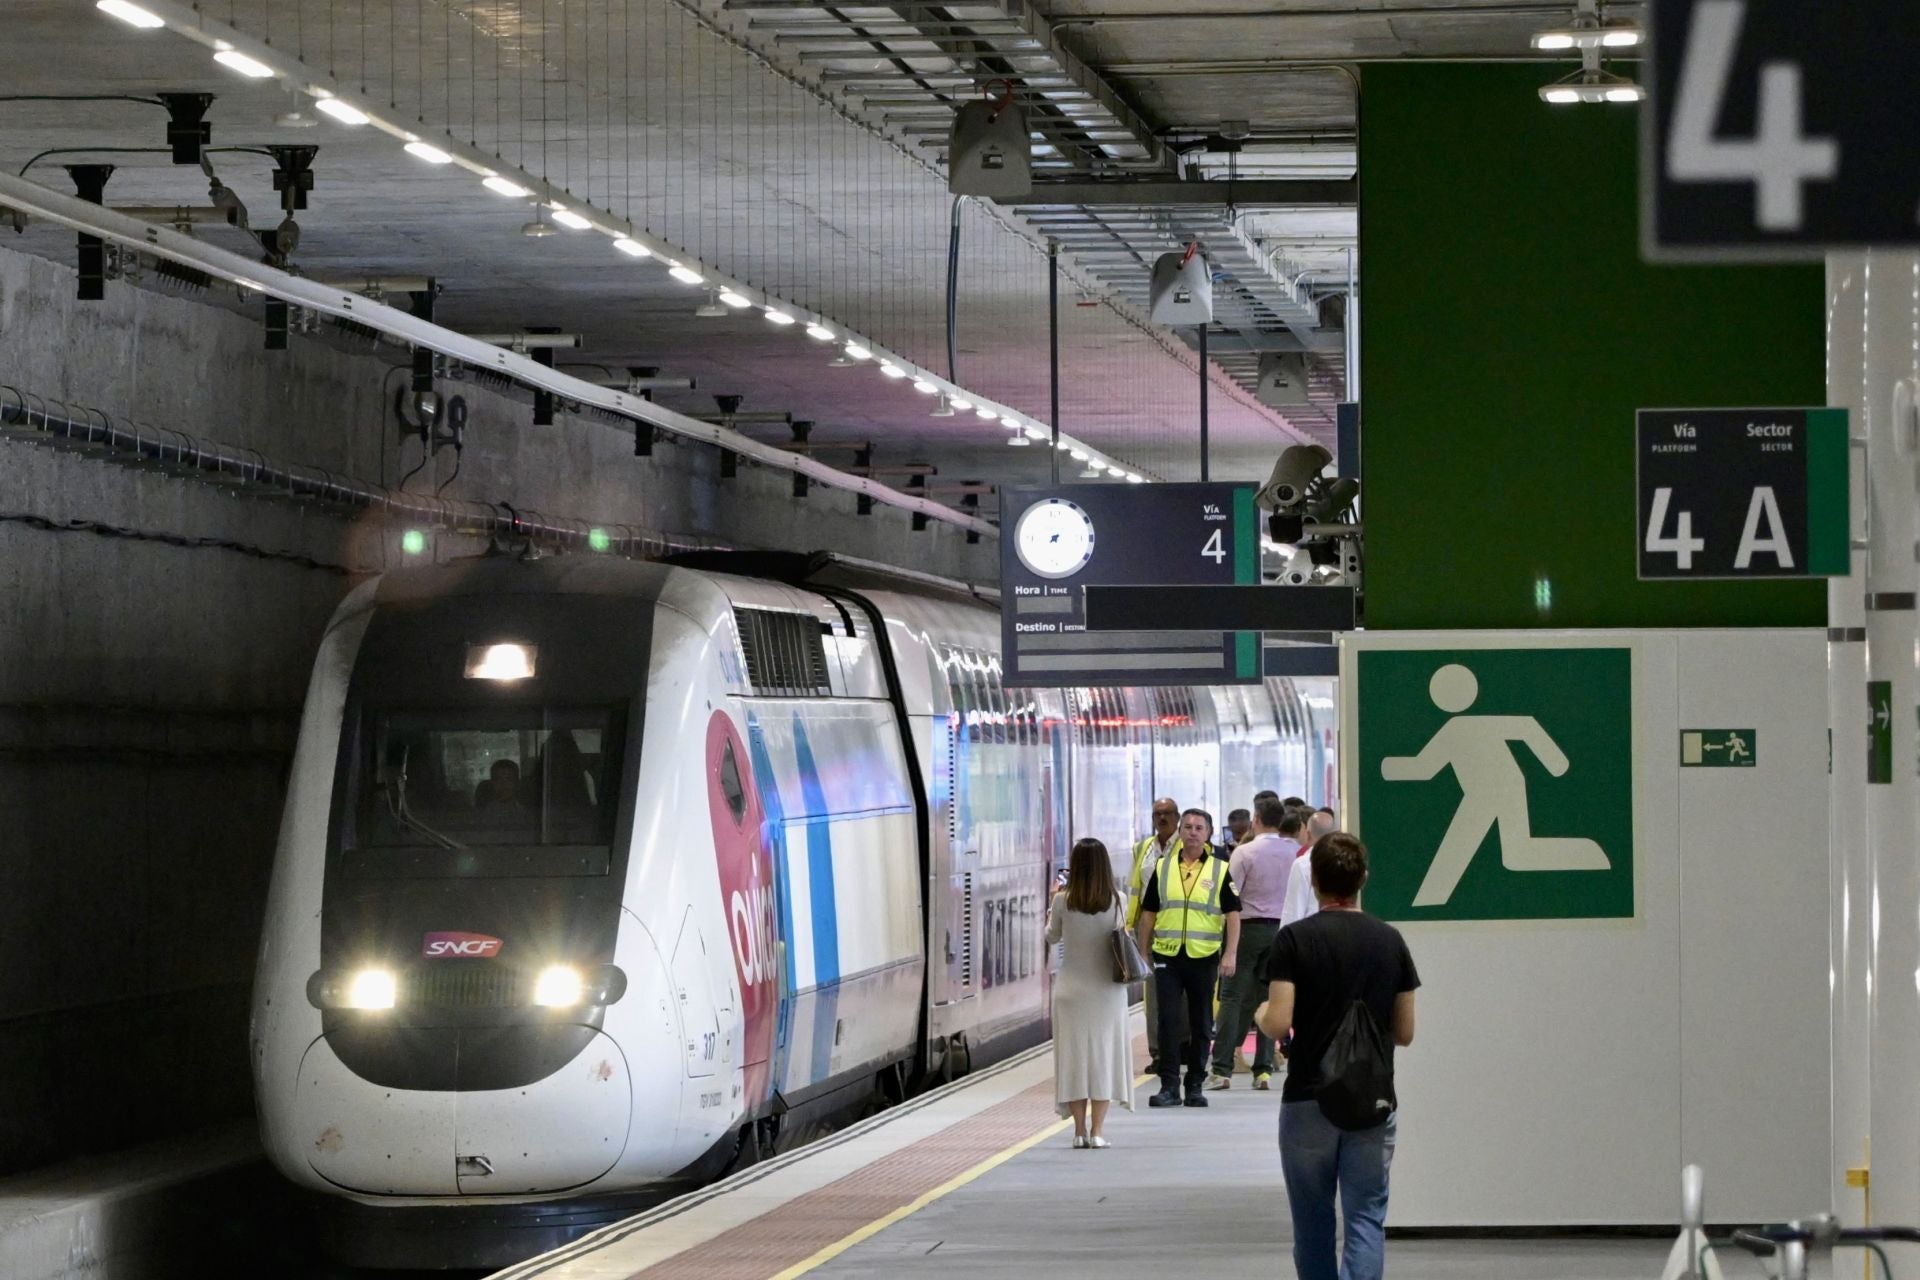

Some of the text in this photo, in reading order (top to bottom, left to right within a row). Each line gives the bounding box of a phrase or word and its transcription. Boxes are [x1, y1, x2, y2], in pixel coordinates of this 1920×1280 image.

[1666, 0, 1840, 231] 4
[1673, 423, 1793, 437] Vía Sector
[1651, 443, 1793, 453] PLATFORM SECTOR
[1203, 503, 1220, 514] Vía
[1645, 486, 1795, 570] 4 A
[1201, 528, 1227, 564] 4
[1015, 585, 1041, 595] Hora
[1015, 622, 1056, 632] Destino
[426, 940, 499, 955] SNCF
